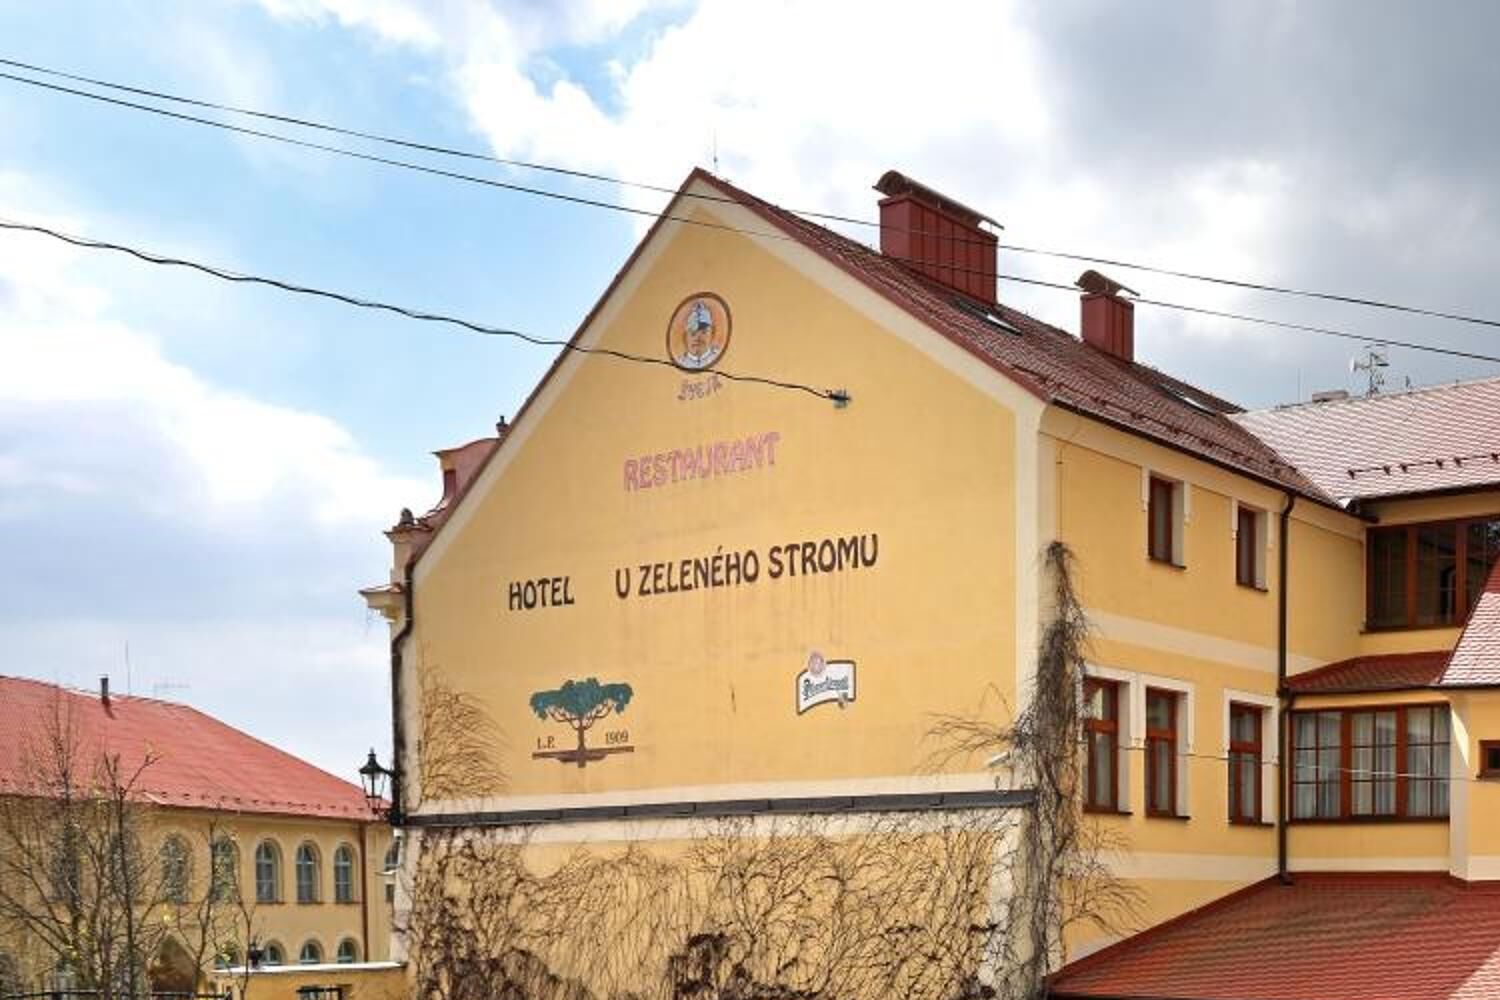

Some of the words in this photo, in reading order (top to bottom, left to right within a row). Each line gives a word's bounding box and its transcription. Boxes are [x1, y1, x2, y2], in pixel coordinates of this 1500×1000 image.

[623, 431, 780, 493] RESTAURANT
[508, 575, 575, 611] HOTEL
[615, 567, 631, 599] U
[638, 545, 759, 597] ZELENÉHO
[767, 533, 879, 579] STROMU
